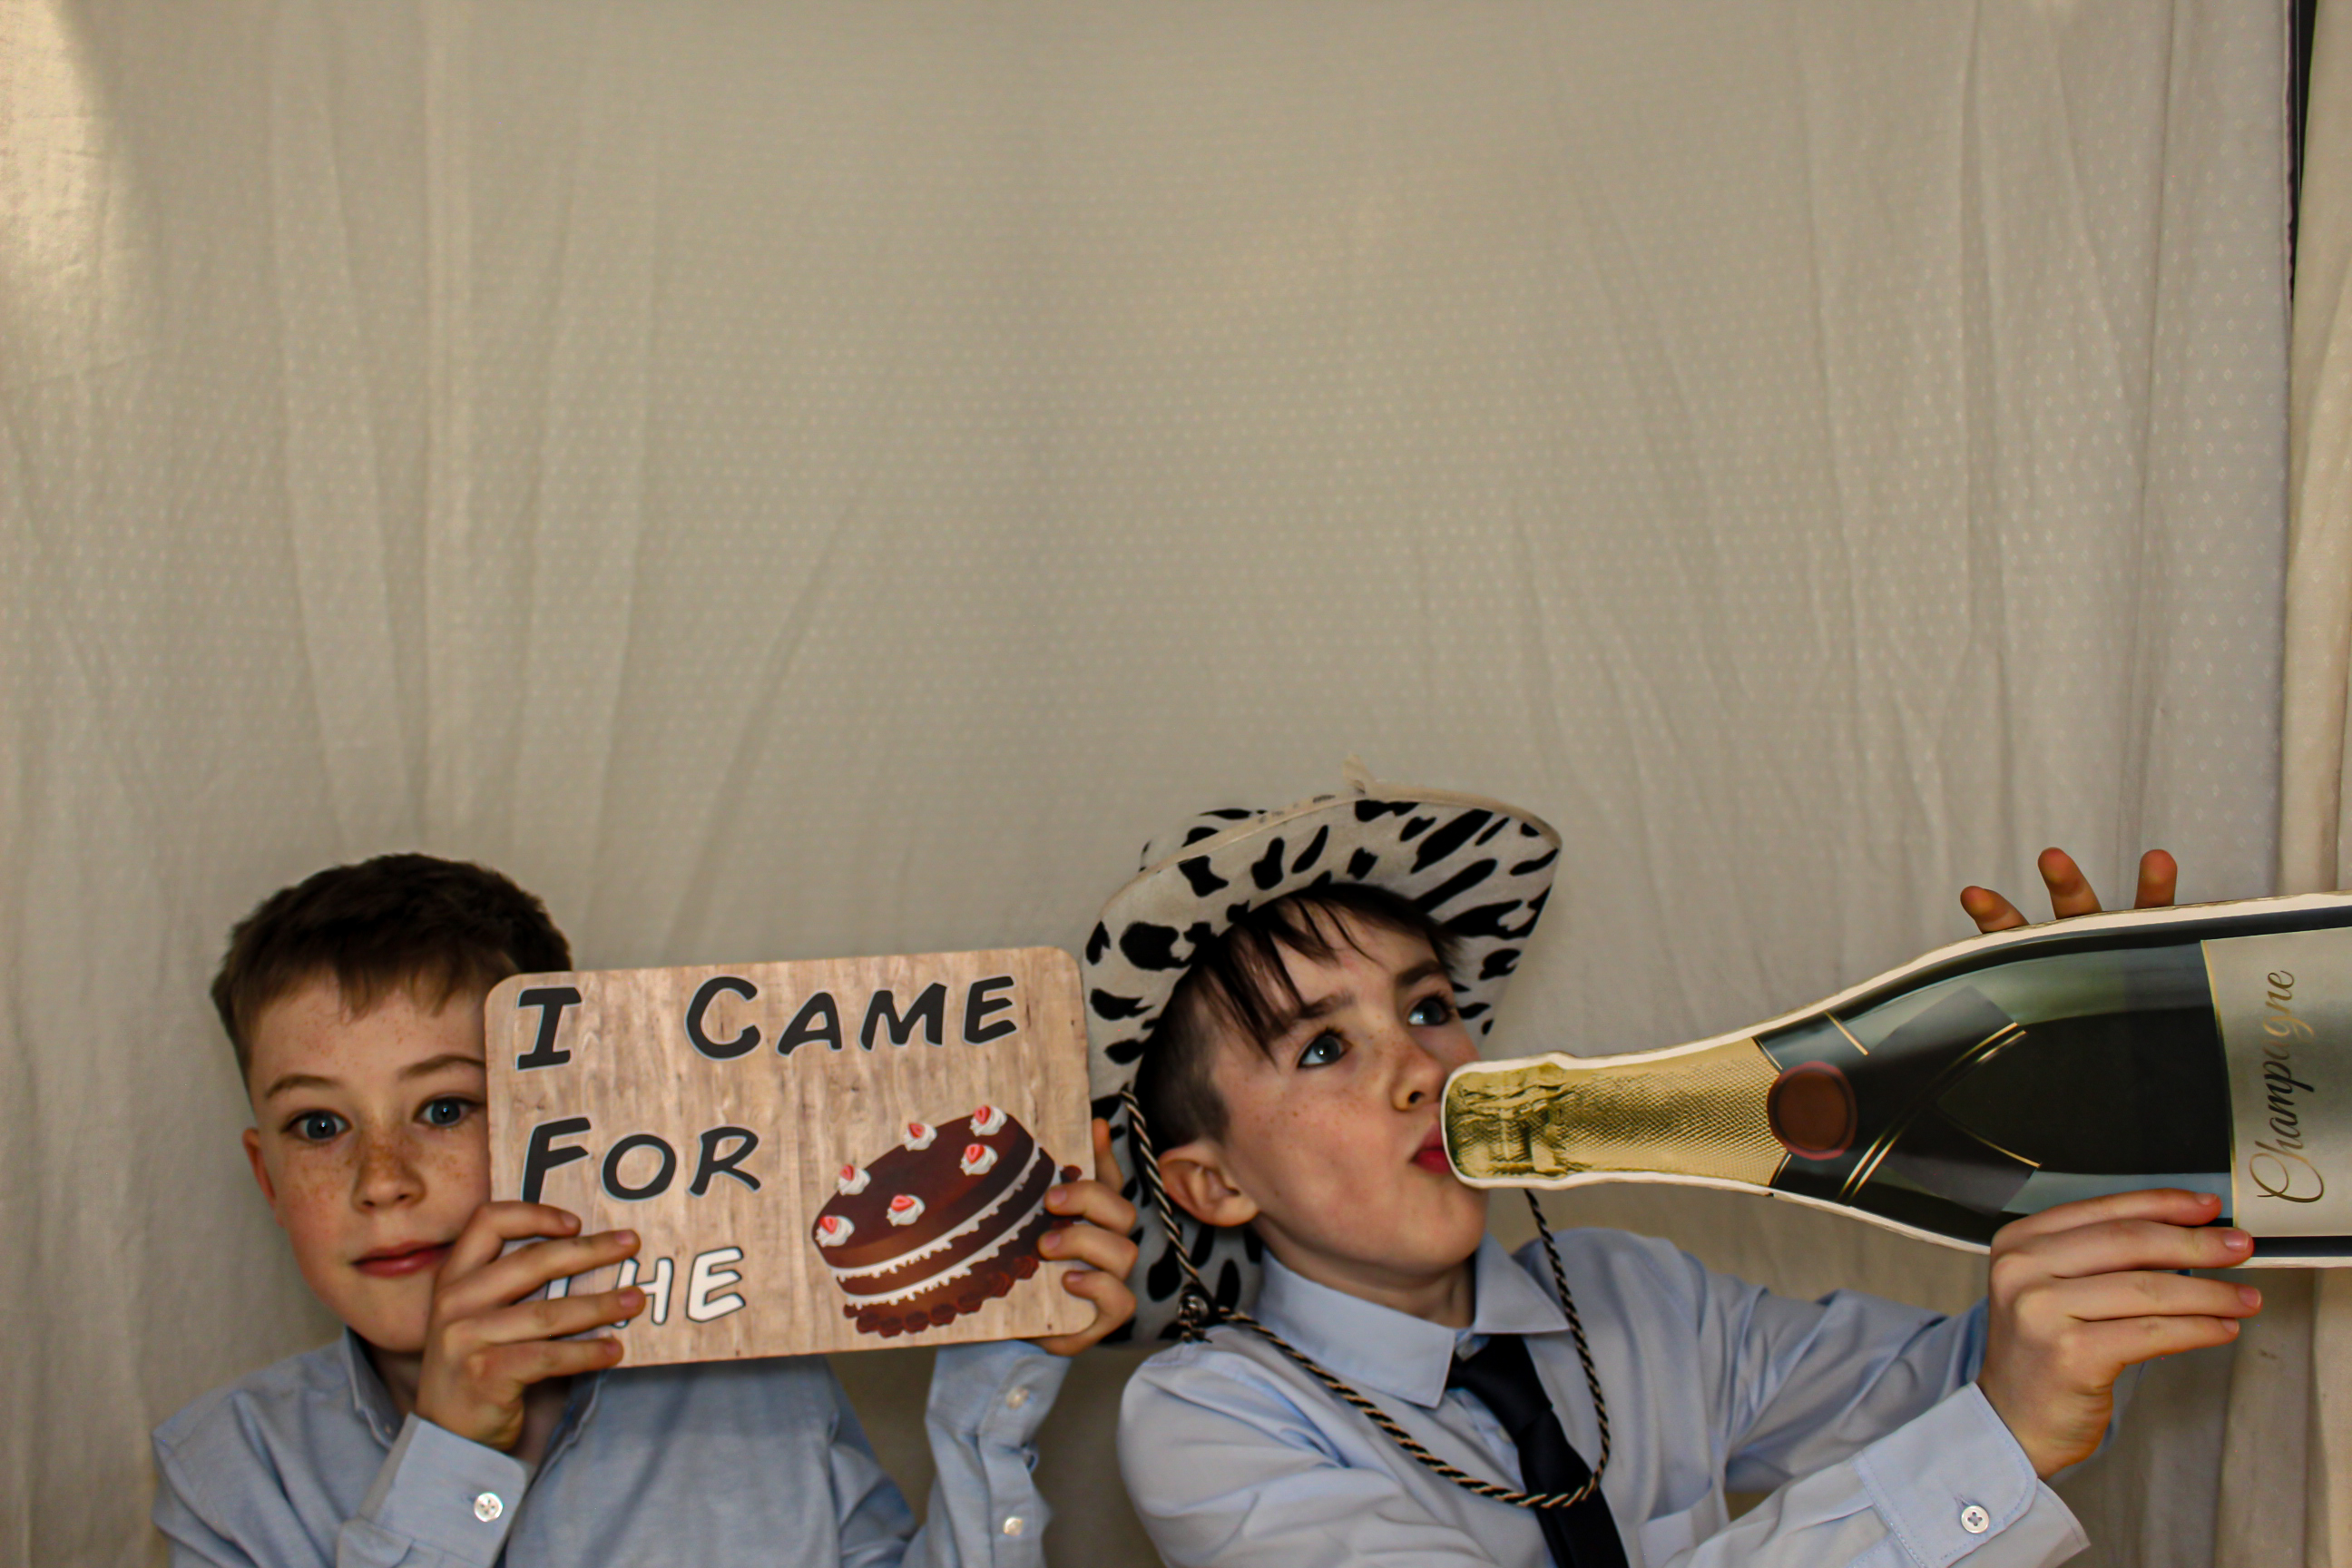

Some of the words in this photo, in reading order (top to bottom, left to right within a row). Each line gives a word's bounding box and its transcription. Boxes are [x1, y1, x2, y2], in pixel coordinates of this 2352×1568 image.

[515, 986, 582, 1070] I
[686, 975, 1017, 1060] CAME
[2249, 969, 2325, 1203] Champagne
[522, 1117, 762, 1203] FOR
[543, 1246, 747, 1329] HE
